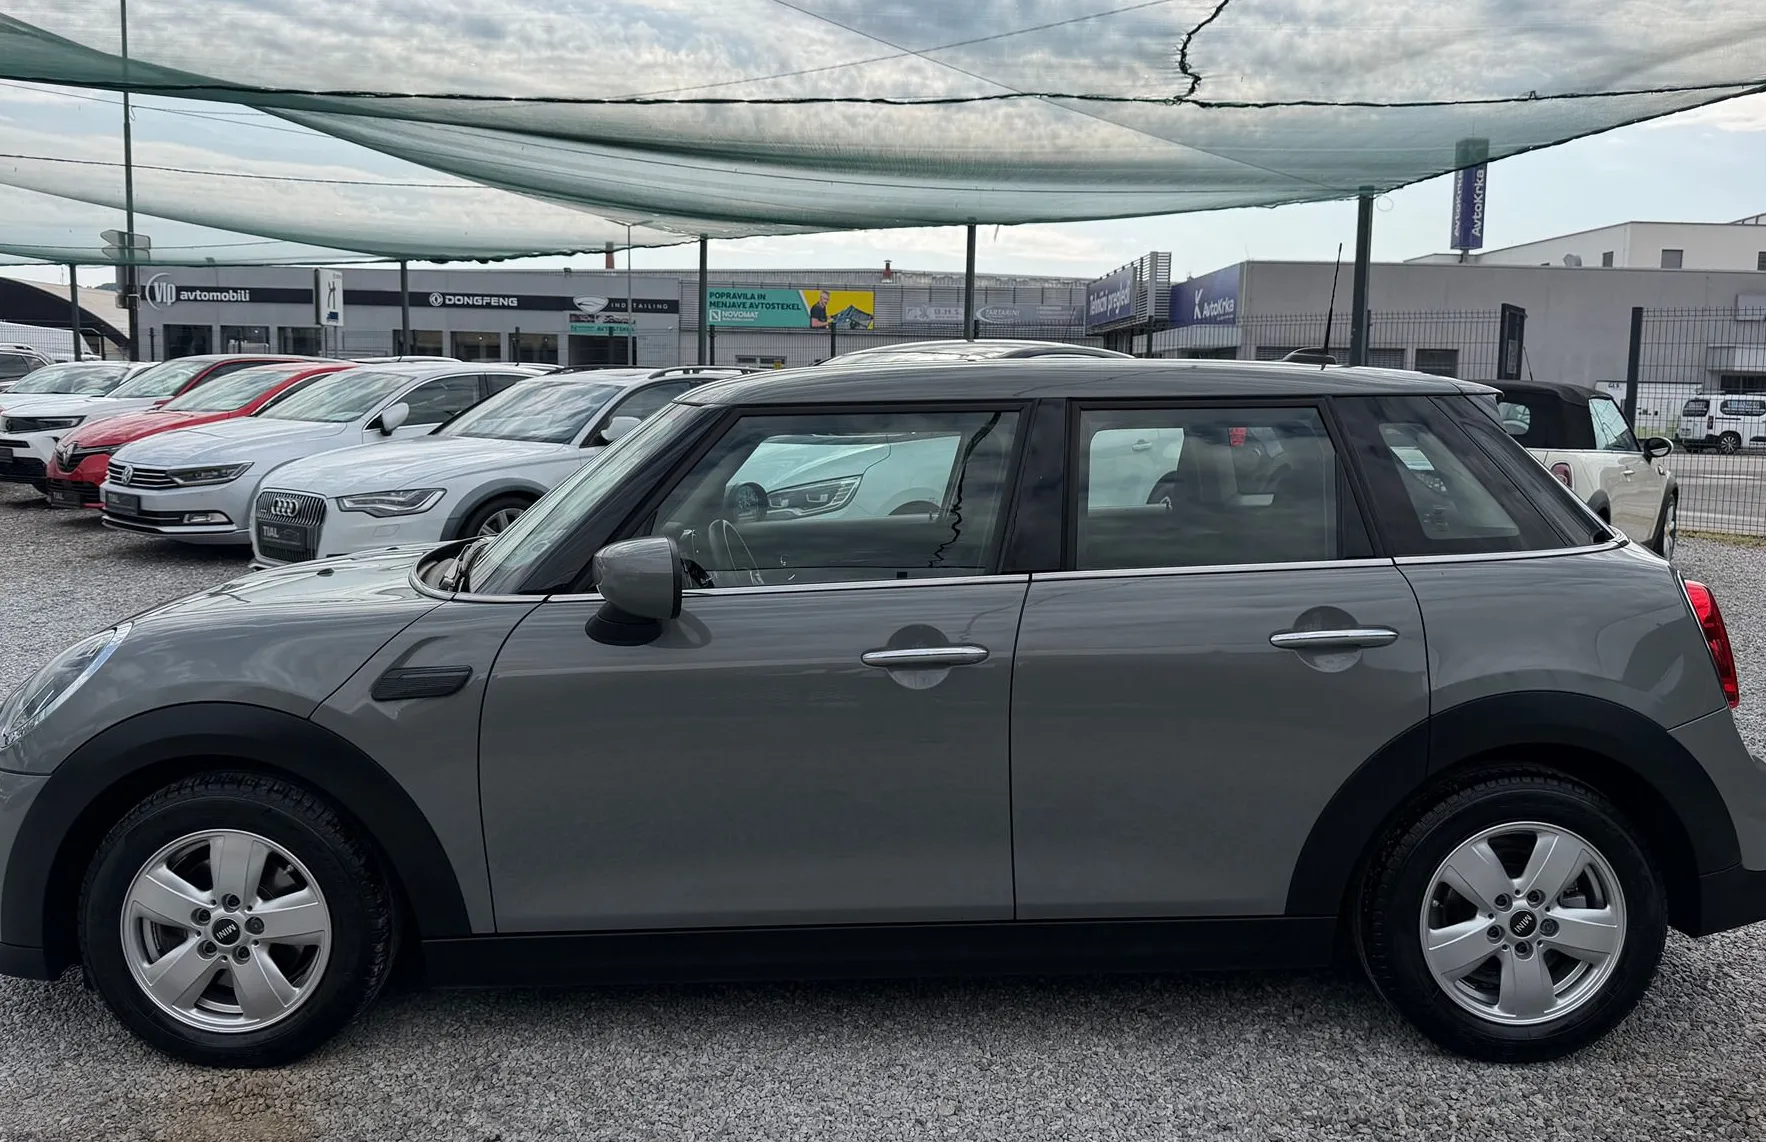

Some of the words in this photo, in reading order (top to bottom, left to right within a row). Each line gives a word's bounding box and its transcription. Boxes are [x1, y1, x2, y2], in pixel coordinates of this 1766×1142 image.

[1471, 169, 1485, 237] AvtoKrka
[180, 290, 250, 301] avtomobili
[445, 295, 518, 306] DONGFENG
[709, 291, 755, 300] POPRAVILA
[611, 302, 668, 310] INDTAILING
[709, 300, 748, 309] MENJAVE
[748, 302, 801, 311] AVTOSTEKEL
[1202, 297, 1235, 319] AvtoKrka
[262, 525, 279, 538] TIAL
[1514, 914, 1533, 933] MINI
[216, 923, 237, 940] MINI
